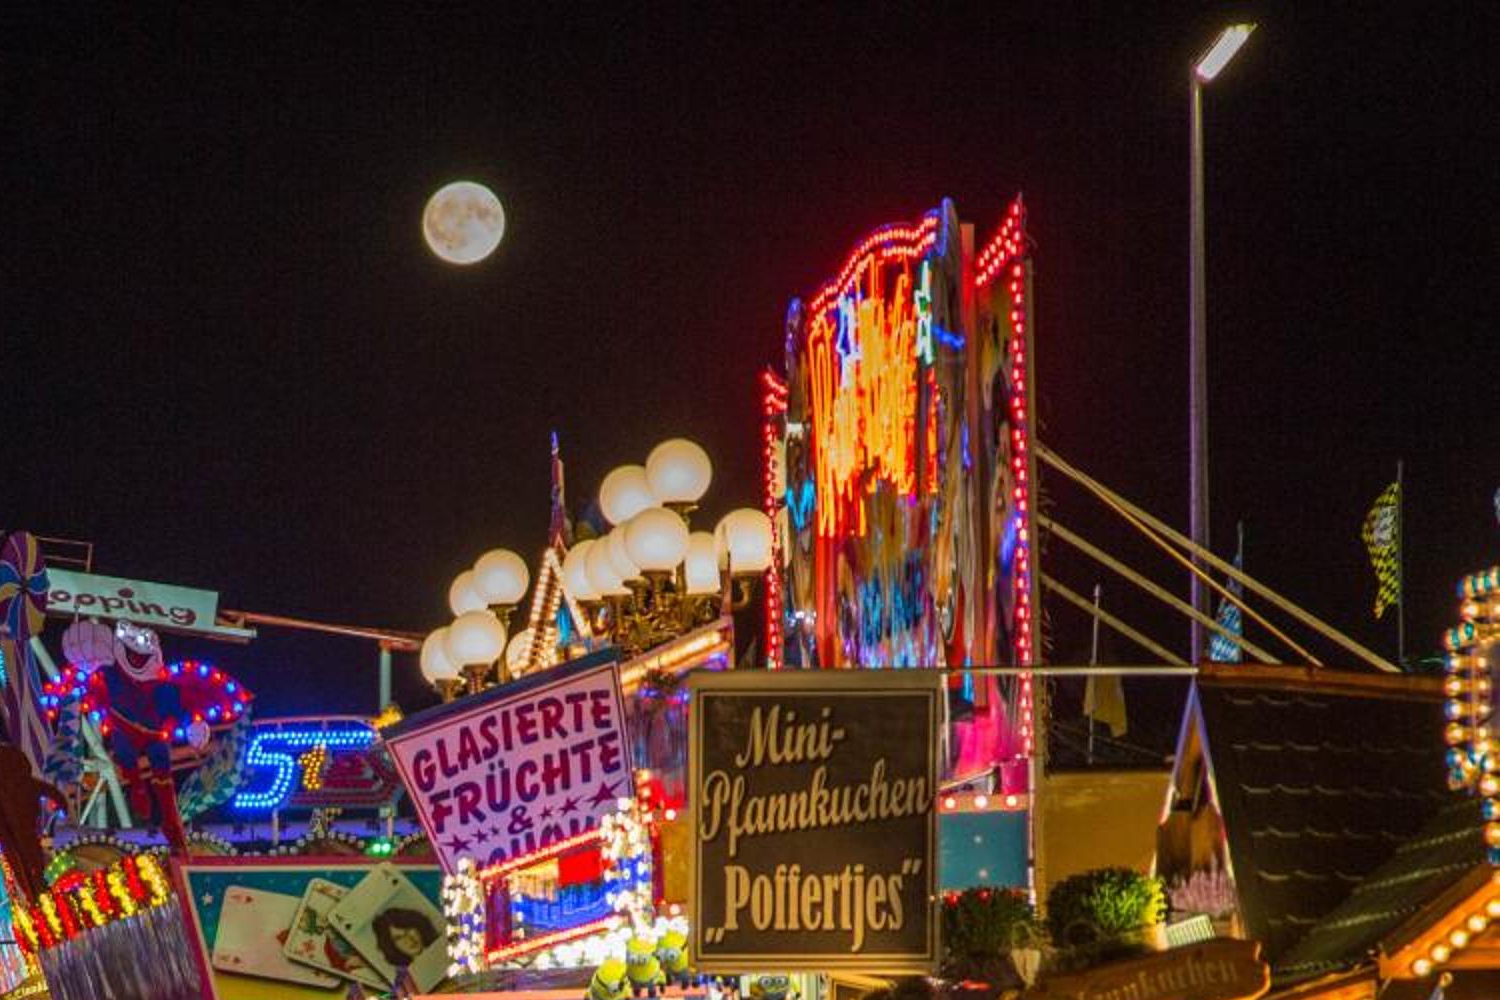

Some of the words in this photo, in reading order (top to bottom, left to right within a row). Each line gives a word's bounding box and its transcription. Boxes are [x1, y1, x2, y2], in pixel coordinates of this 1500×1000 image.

[45, 587, 197, 626] ooping
[412, 689, 613, 793] GLASIERTE
[735, 704, 845, 768] Mini-
[429, 730, 622, 834] FRÜCHTE
[507, 805, 534, 835] &
[700, 758, 934, 857] Pfannkuchen
